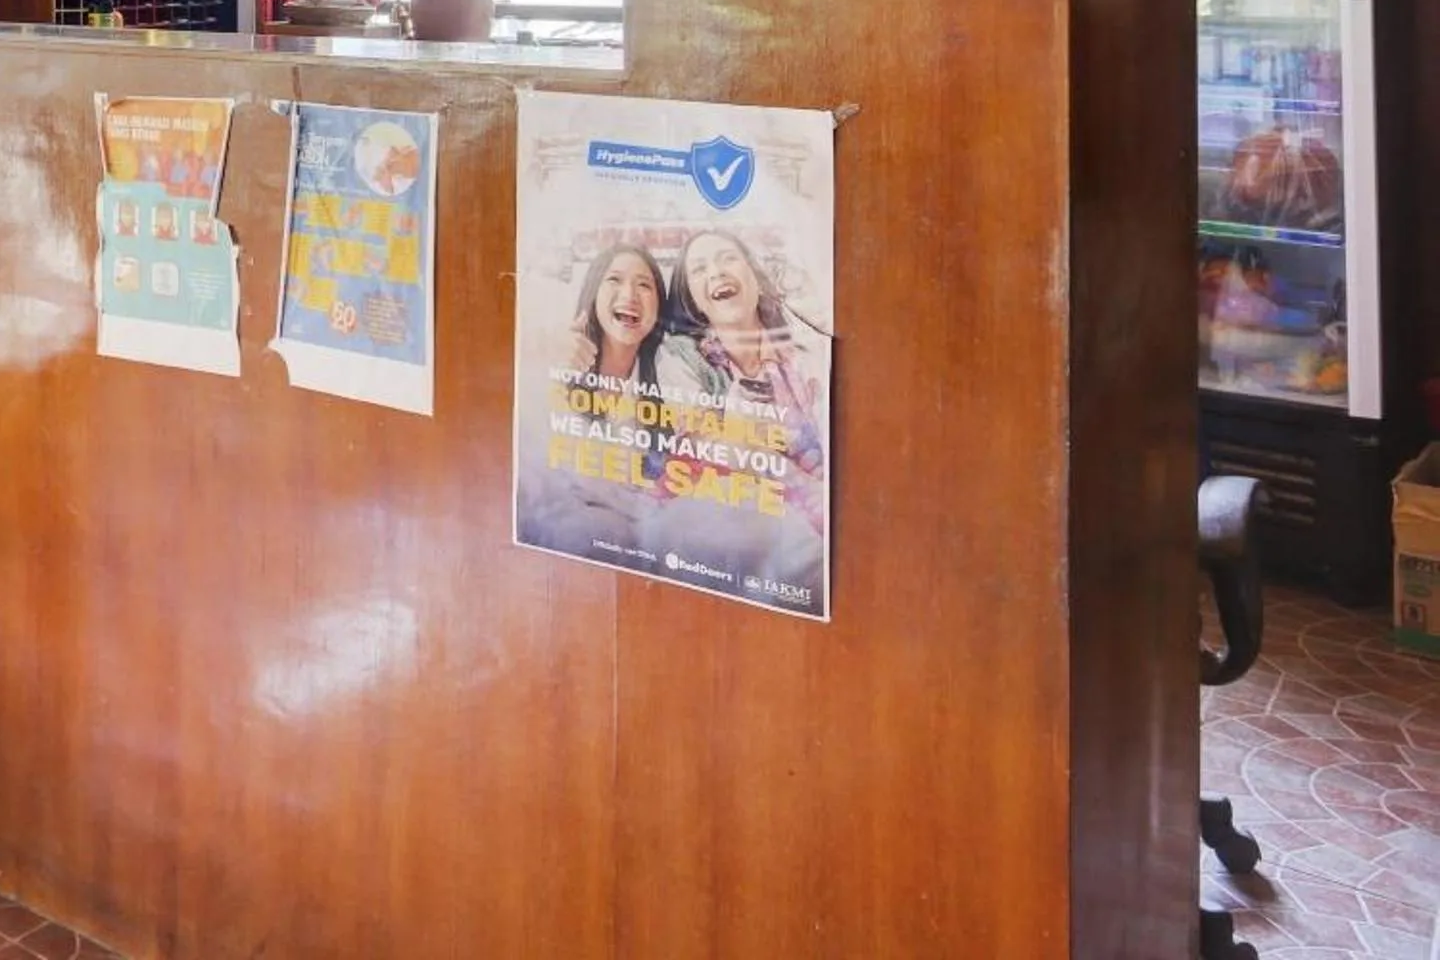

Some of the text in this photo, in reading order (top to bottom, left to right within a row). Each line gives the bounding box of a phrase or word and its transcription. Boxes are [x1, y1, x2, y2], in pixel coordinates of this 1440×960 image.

[549, 367, 788, 422] NOT ONLY MAKE YOUR STAY
[548, 437, 787, 517] FEEL SAFE
[550, 412, 788, 477] WE ALSO MAKE YOU
